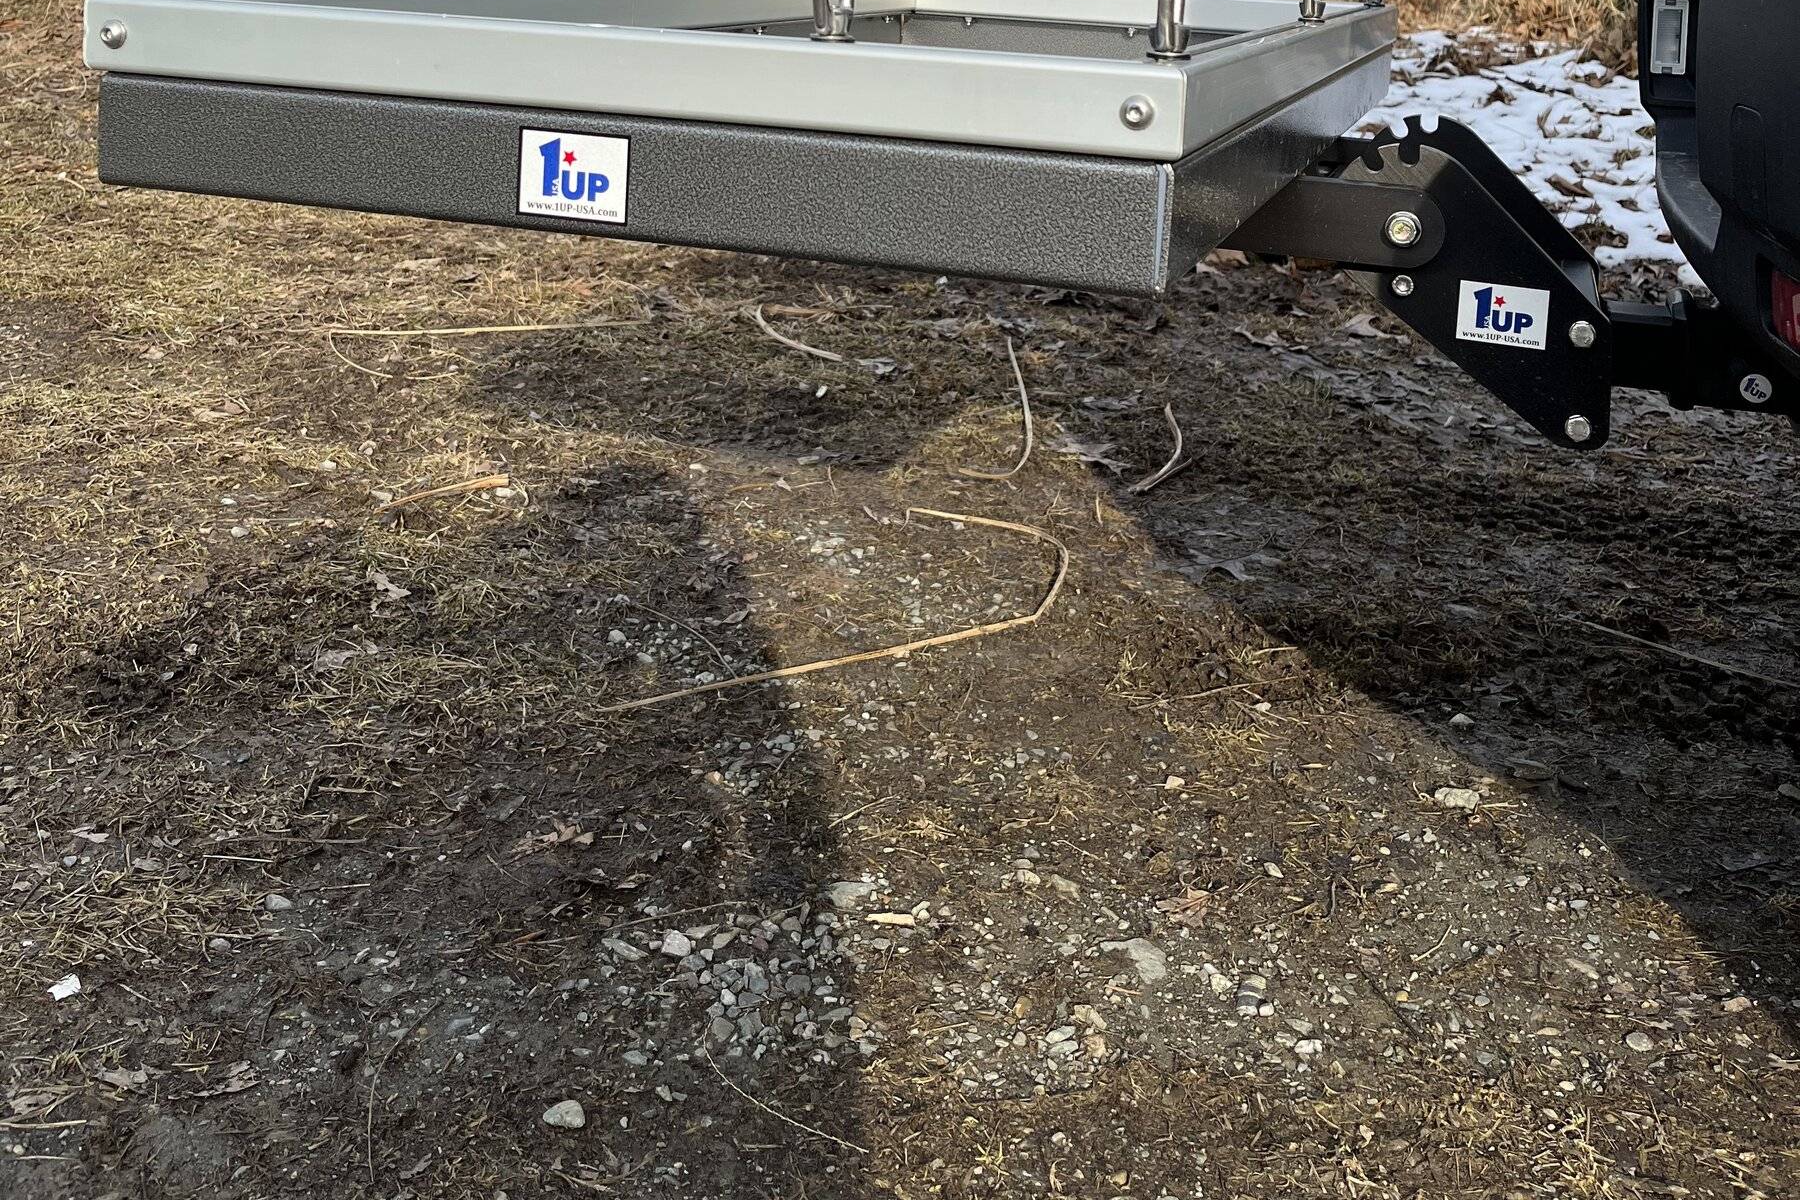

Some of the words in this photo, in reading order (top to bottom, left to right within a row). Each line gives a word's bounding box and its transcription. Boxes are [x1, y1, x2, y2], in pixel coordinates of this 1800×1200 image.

[539, 138, 610, 202] 1UP
[527, 201, 618, 218] www.1UP-USA.com
[1473, 287, 1534, 334] 1UP
[1462, 331, 1540, 346] www.1UP-USA.com
[1743, 378, 1767, 399] 1UP
